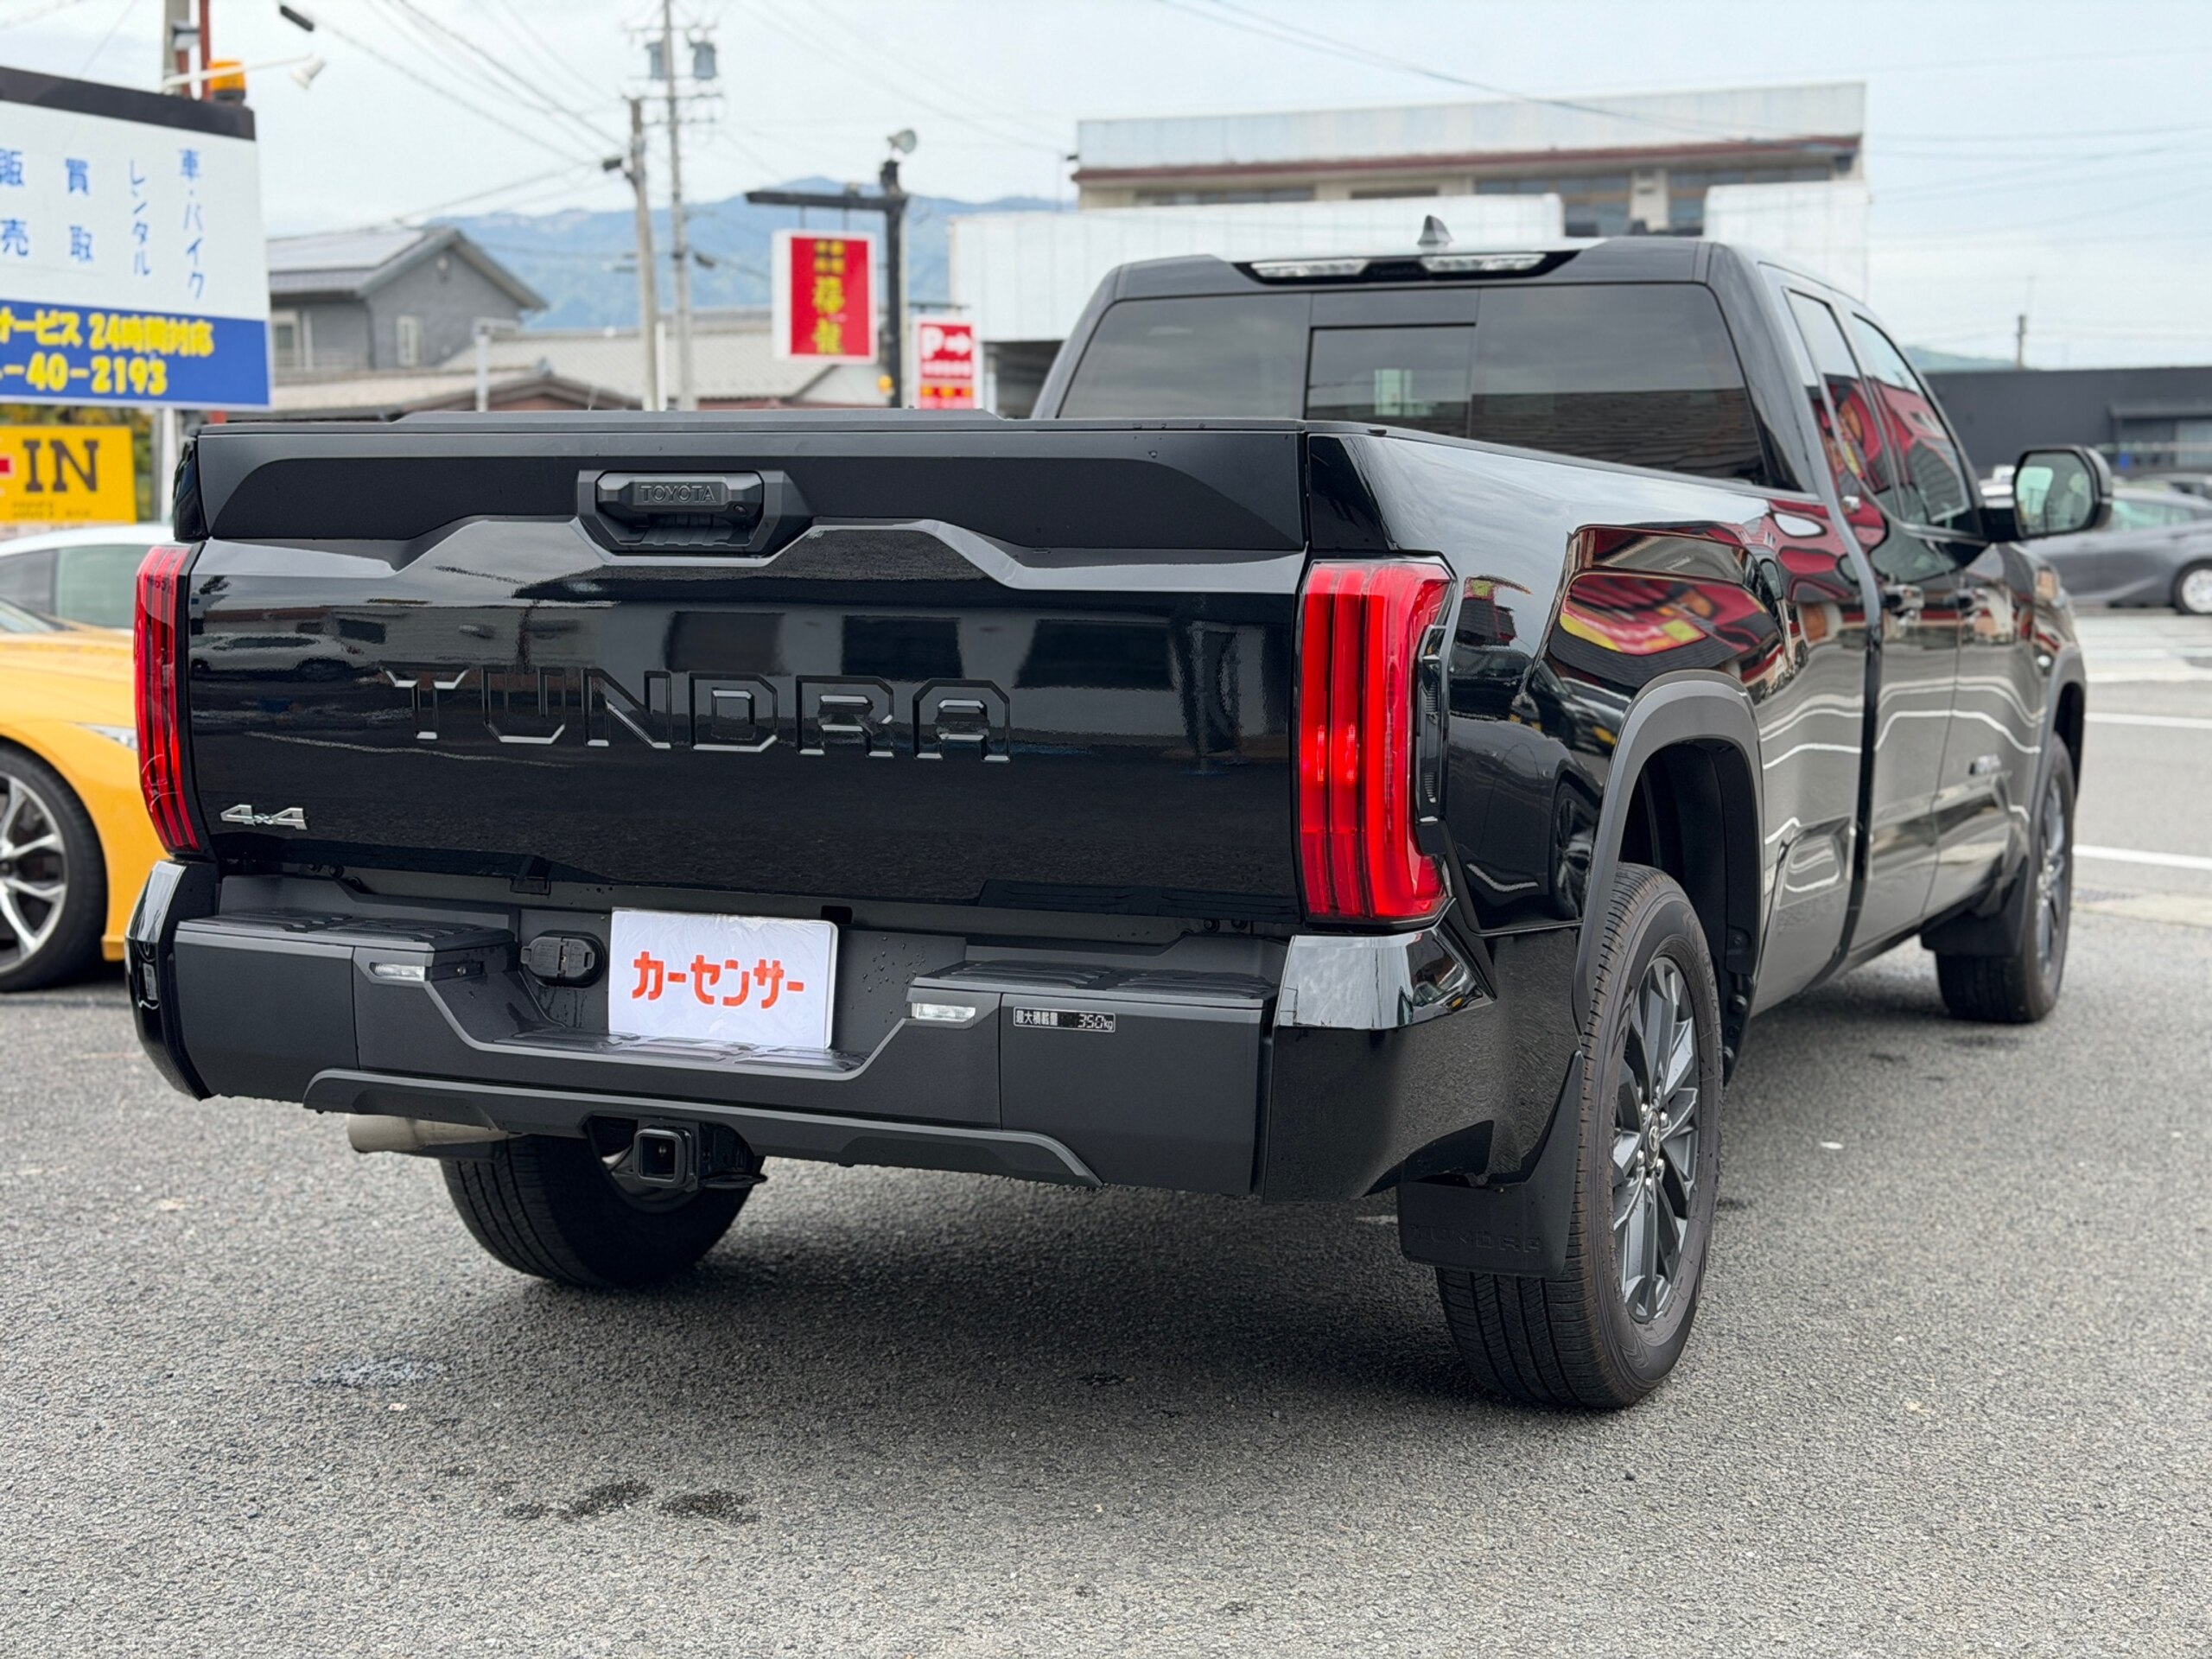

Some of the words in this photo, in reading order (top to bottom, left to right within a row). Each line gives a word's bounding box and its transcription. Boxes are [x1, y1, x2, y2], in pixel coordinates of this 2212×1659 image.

[66, 158, 93, 262] 買取
[130, 159, 151, 276] レンタル
[921, 327, 944, 359] P
[0, 352, 168, 396] -40-2193
[22, 439, 99, 493] IN
[640, 485, 716, 504] TOYOTA
[380, 661, 1010, 762] TUNDRA
[632, 951, 804, 1009] カーセンサー
[1015, 1010, 1058, 1027] 最大積載量
